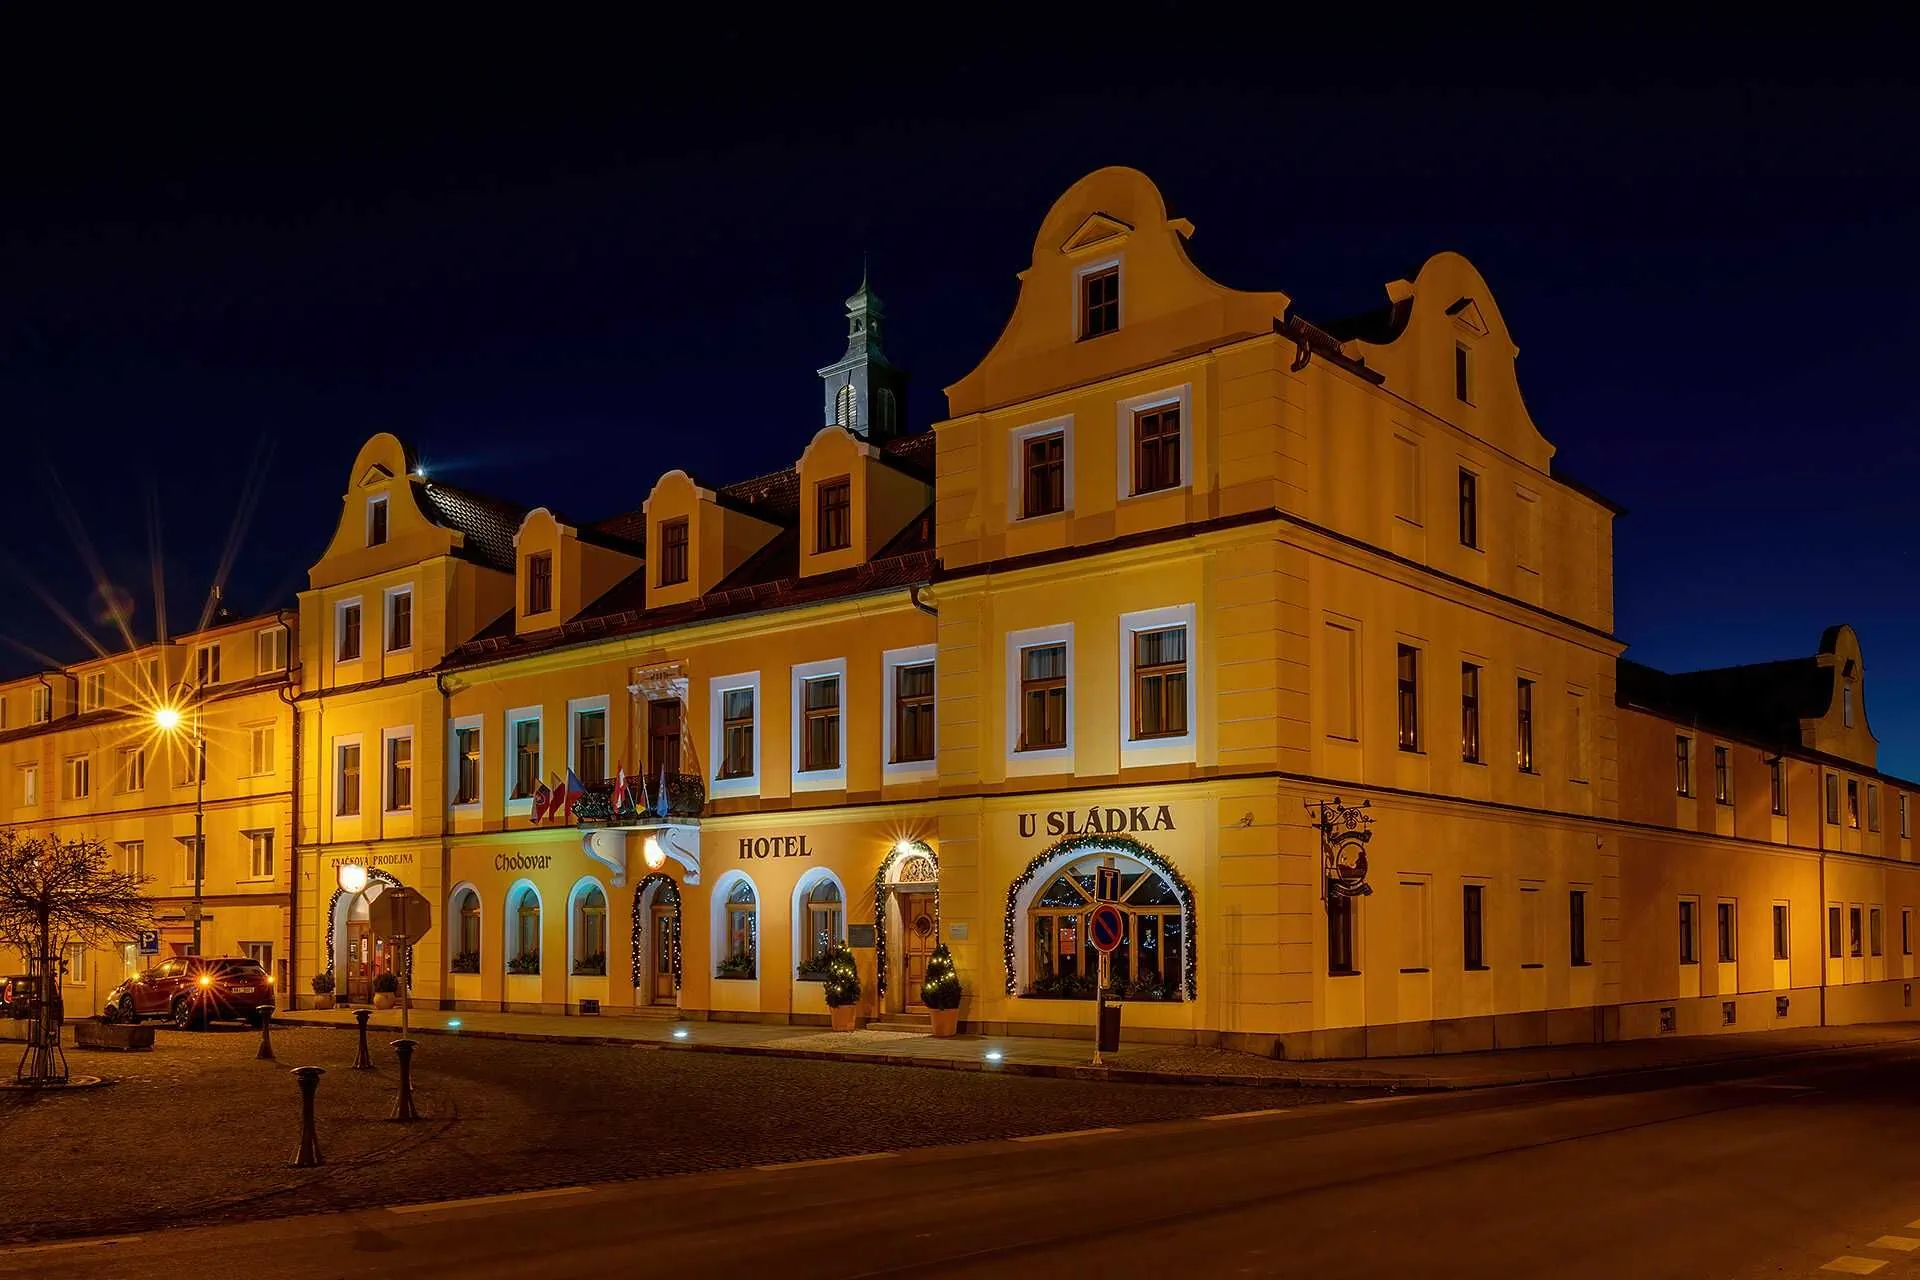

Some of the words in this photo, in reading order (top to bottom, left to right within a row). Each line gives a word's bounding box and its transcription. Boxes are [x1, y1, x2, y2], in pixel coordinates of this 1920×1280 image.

[1018, 813, 1037, 838] U
[1046, 805, 1176, 837] SLÁDKA
[373, 853, 414, 865] PRODEJNA
[739, 835, 813, 859] HOTEL
